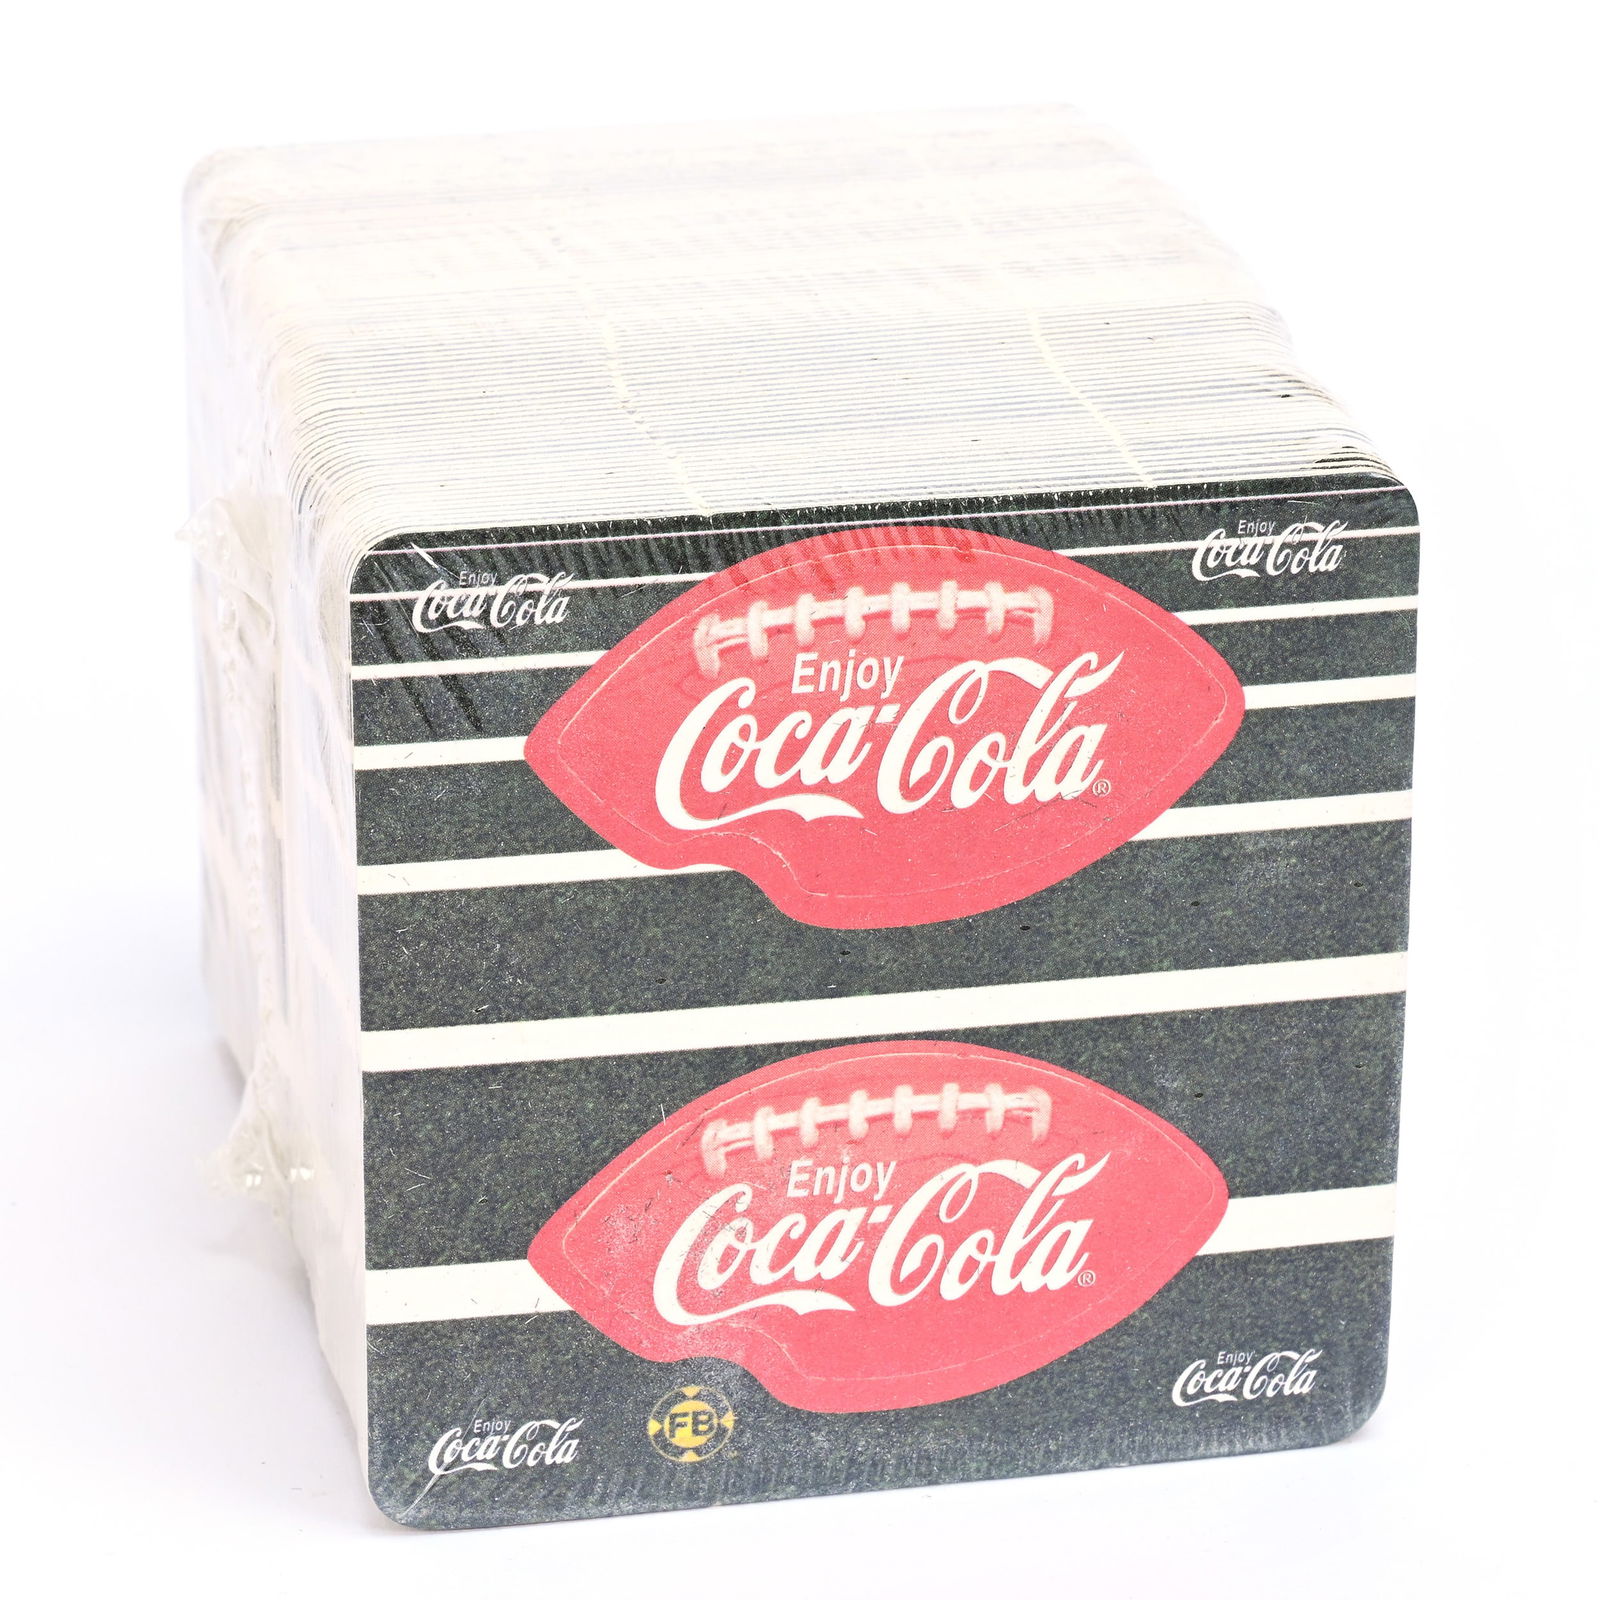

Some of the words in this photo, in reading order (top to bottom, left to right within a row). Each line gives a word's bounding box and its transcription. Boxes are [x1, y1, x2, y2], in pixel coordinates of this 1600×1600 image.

[1237, 519, 1276, 537] Enjoy
[459, 570, 498, 588] Enjoy
[791, 649, 905, 702] Enjoy
[655, 650, 1124, 830] Coca-Cola
[786, 1156, 899, 1204] Enjoy
[653, 1151, 1111, 1326] Coca-Cola
[1172, 1348, 1323, 1407] Coca-Cola
[1217, 1350, 1255, 1367] Enjoy
[428, 1417, 585, 1475] Coca-Cola
[473, 1418, 512, 1436] Enjoy
[669, 1409, 717, 1439] FB
